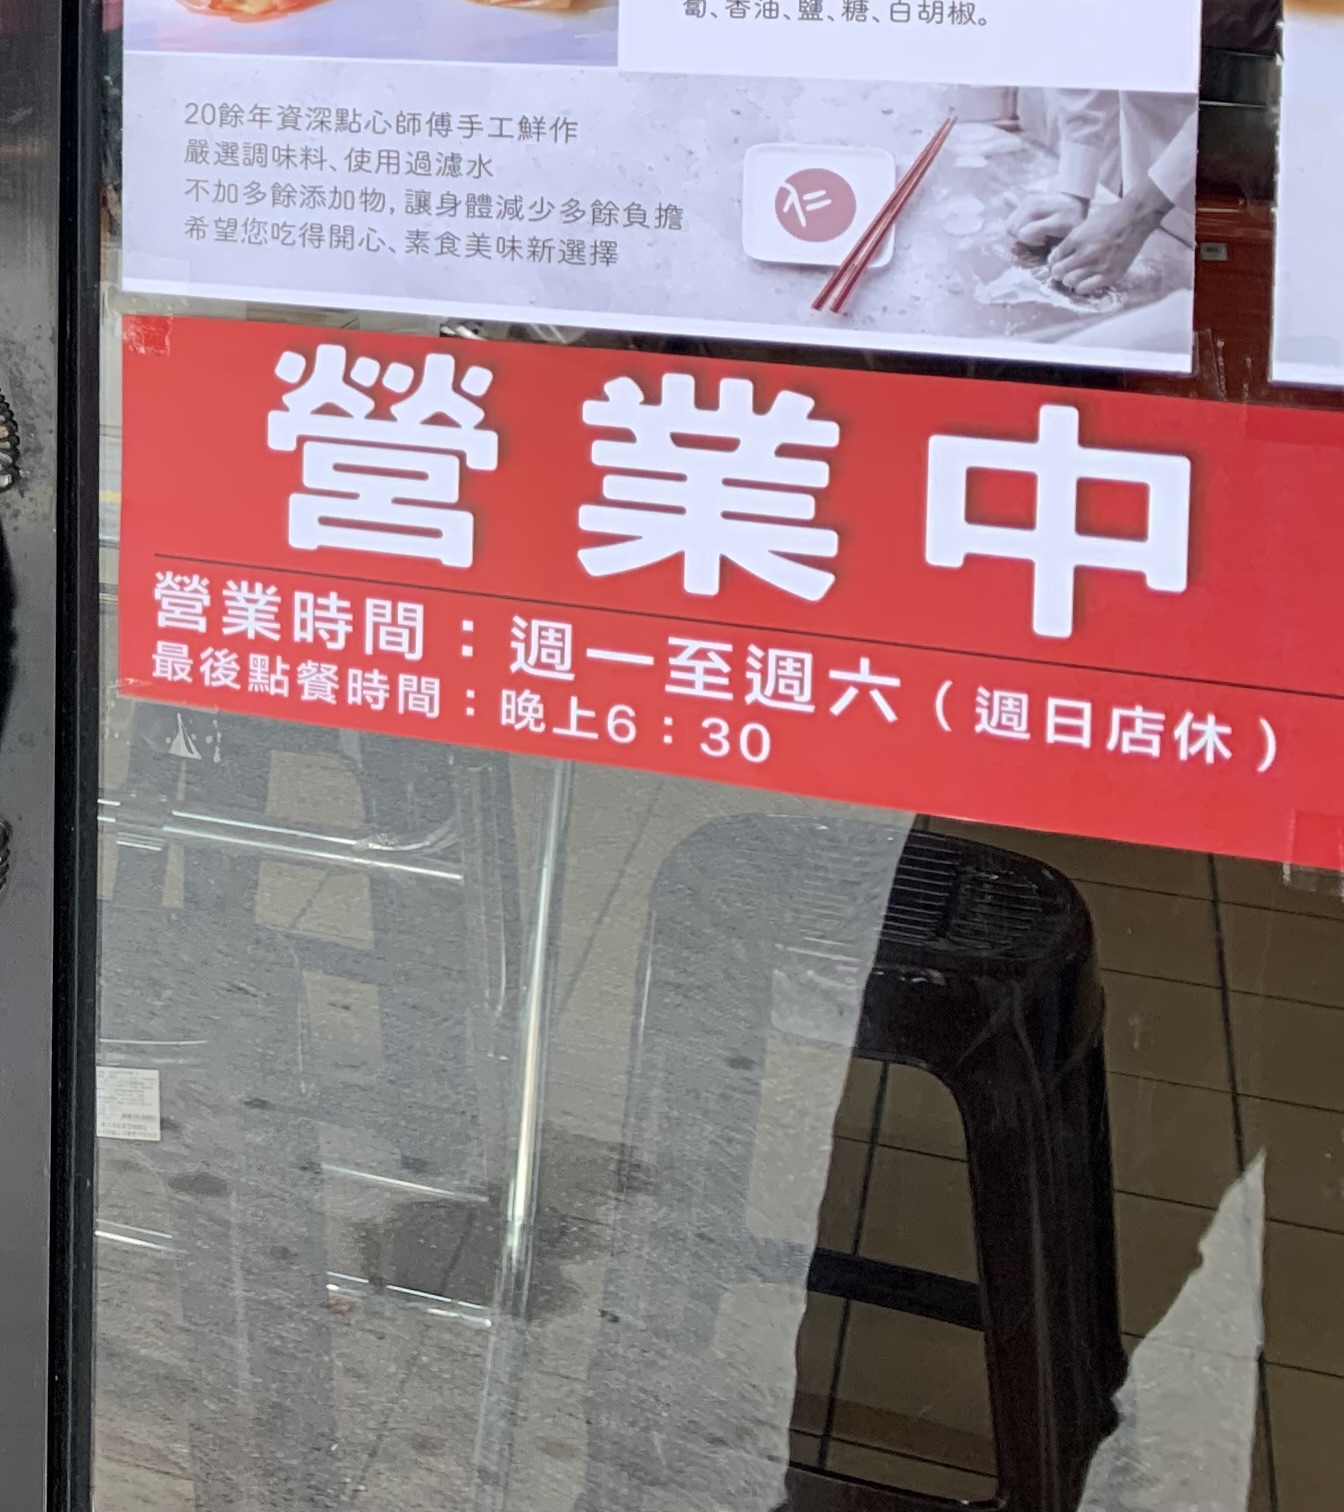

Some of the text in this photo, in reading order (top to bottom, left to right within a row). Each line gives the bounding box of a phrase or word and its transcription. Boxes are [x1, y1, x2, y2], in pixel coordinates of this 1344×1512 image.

[183, 102, 579, 146] 20餘年資深點心師傅手工鮮作
[183, 140, 494, 182] 嚴選調味料、使用過濾水
[183, 215, 620, 268] 希望您吃得開心、素食美味新選擇
[268, 342, 1193, 641] 營業中
